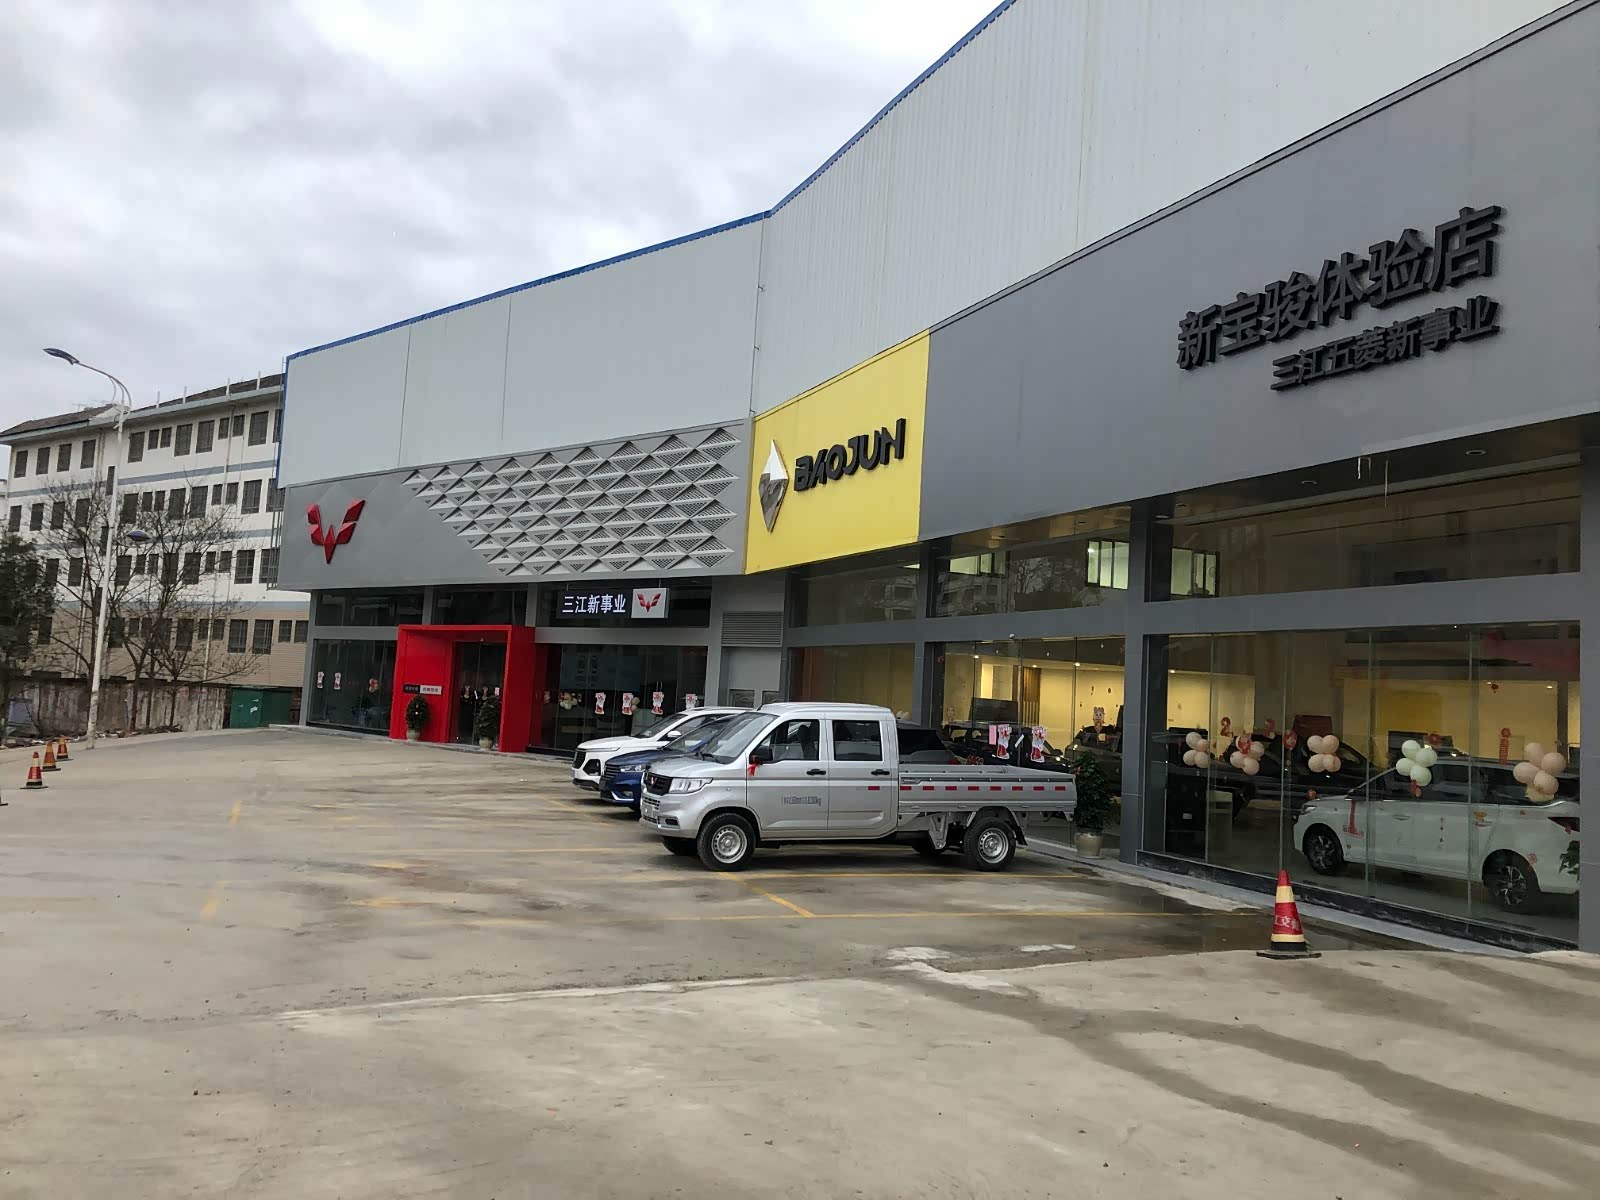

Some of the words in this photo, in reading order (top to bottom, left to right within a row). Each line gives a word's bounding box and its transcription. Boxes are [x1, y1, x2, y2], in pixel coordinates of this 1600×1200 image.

[1176, 205, 1503, 370] 新宝骏体验店
[1270, 295, 1501, 391] 三江五菱新事业
[793, 418, 907, 492] BAOJUN
[562, 594, 626, 614] 三江新事业
